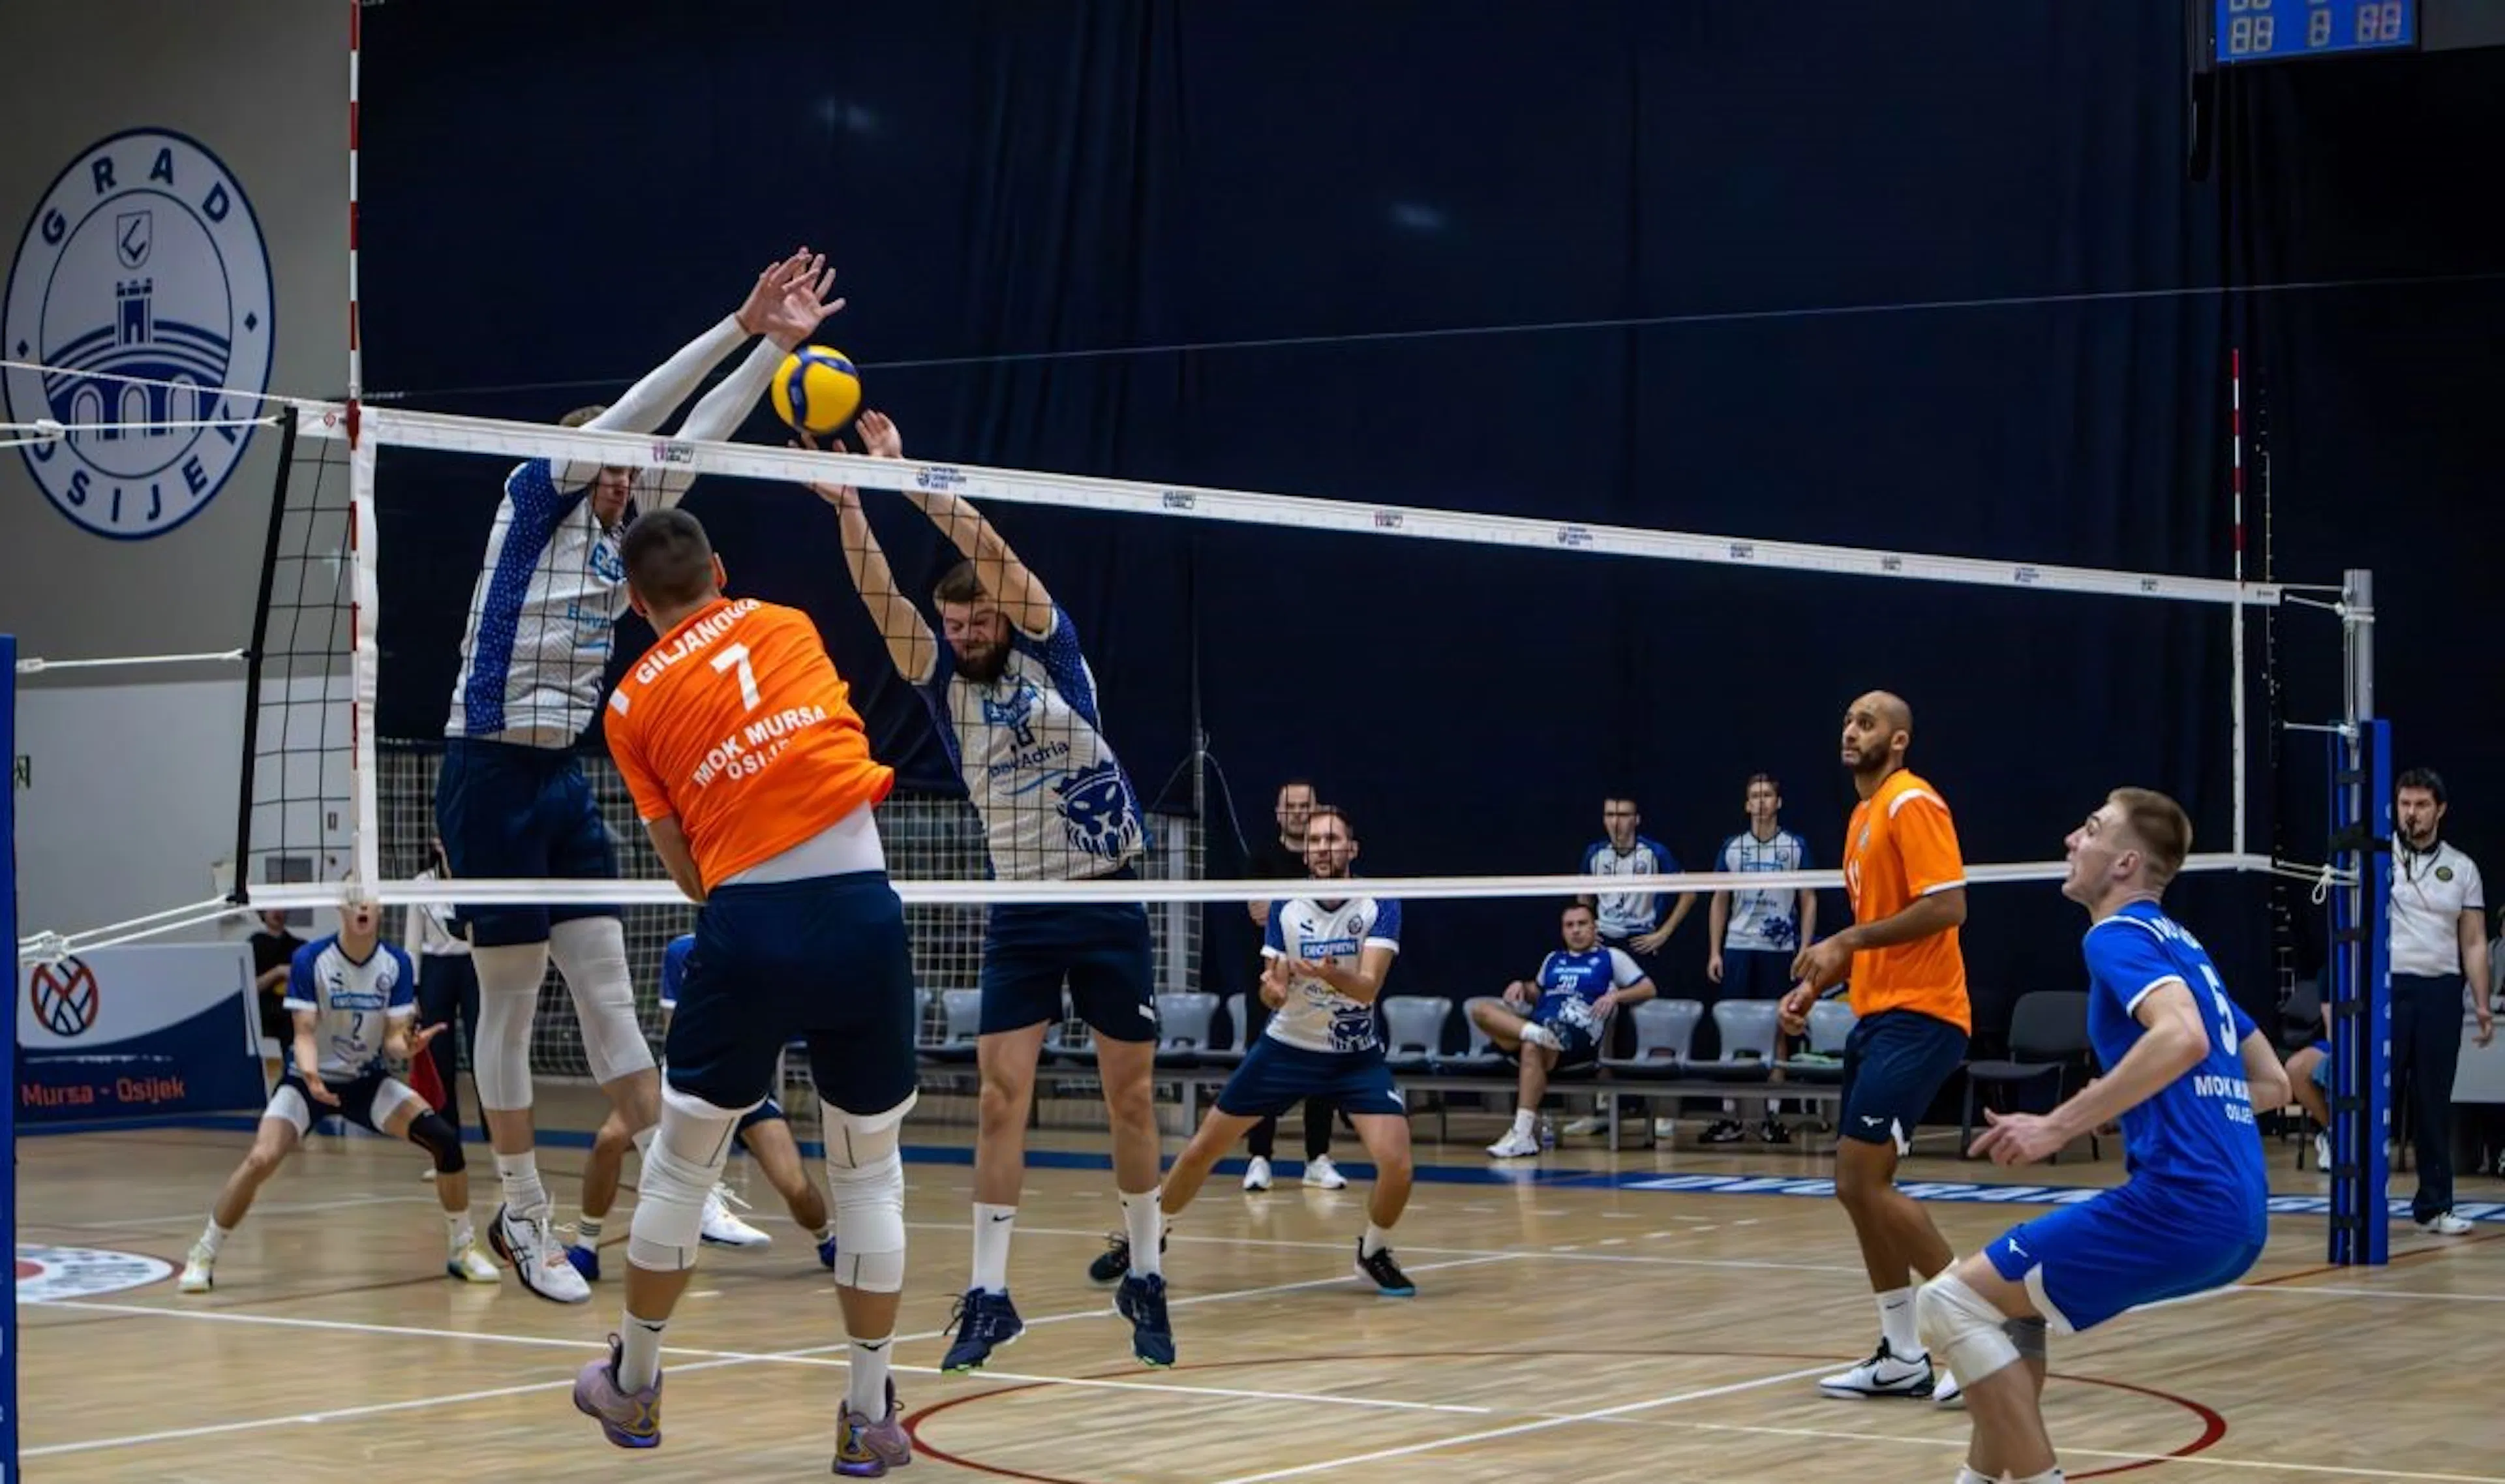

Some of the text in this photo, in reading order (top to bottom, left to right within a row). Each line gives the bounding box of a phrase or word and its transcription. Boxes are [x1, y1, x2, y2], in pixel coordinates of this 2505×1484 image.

[41, 147, 230, 246] GRAD
[710, 642, 761, 712] 7
[692, 704, 827, 788] MOK MURSA
[2199, 963, 2238, 1057] 5
[22, 1082, 94, 1107] Mursa
[115, 1074, 185, 1106] Osijek
